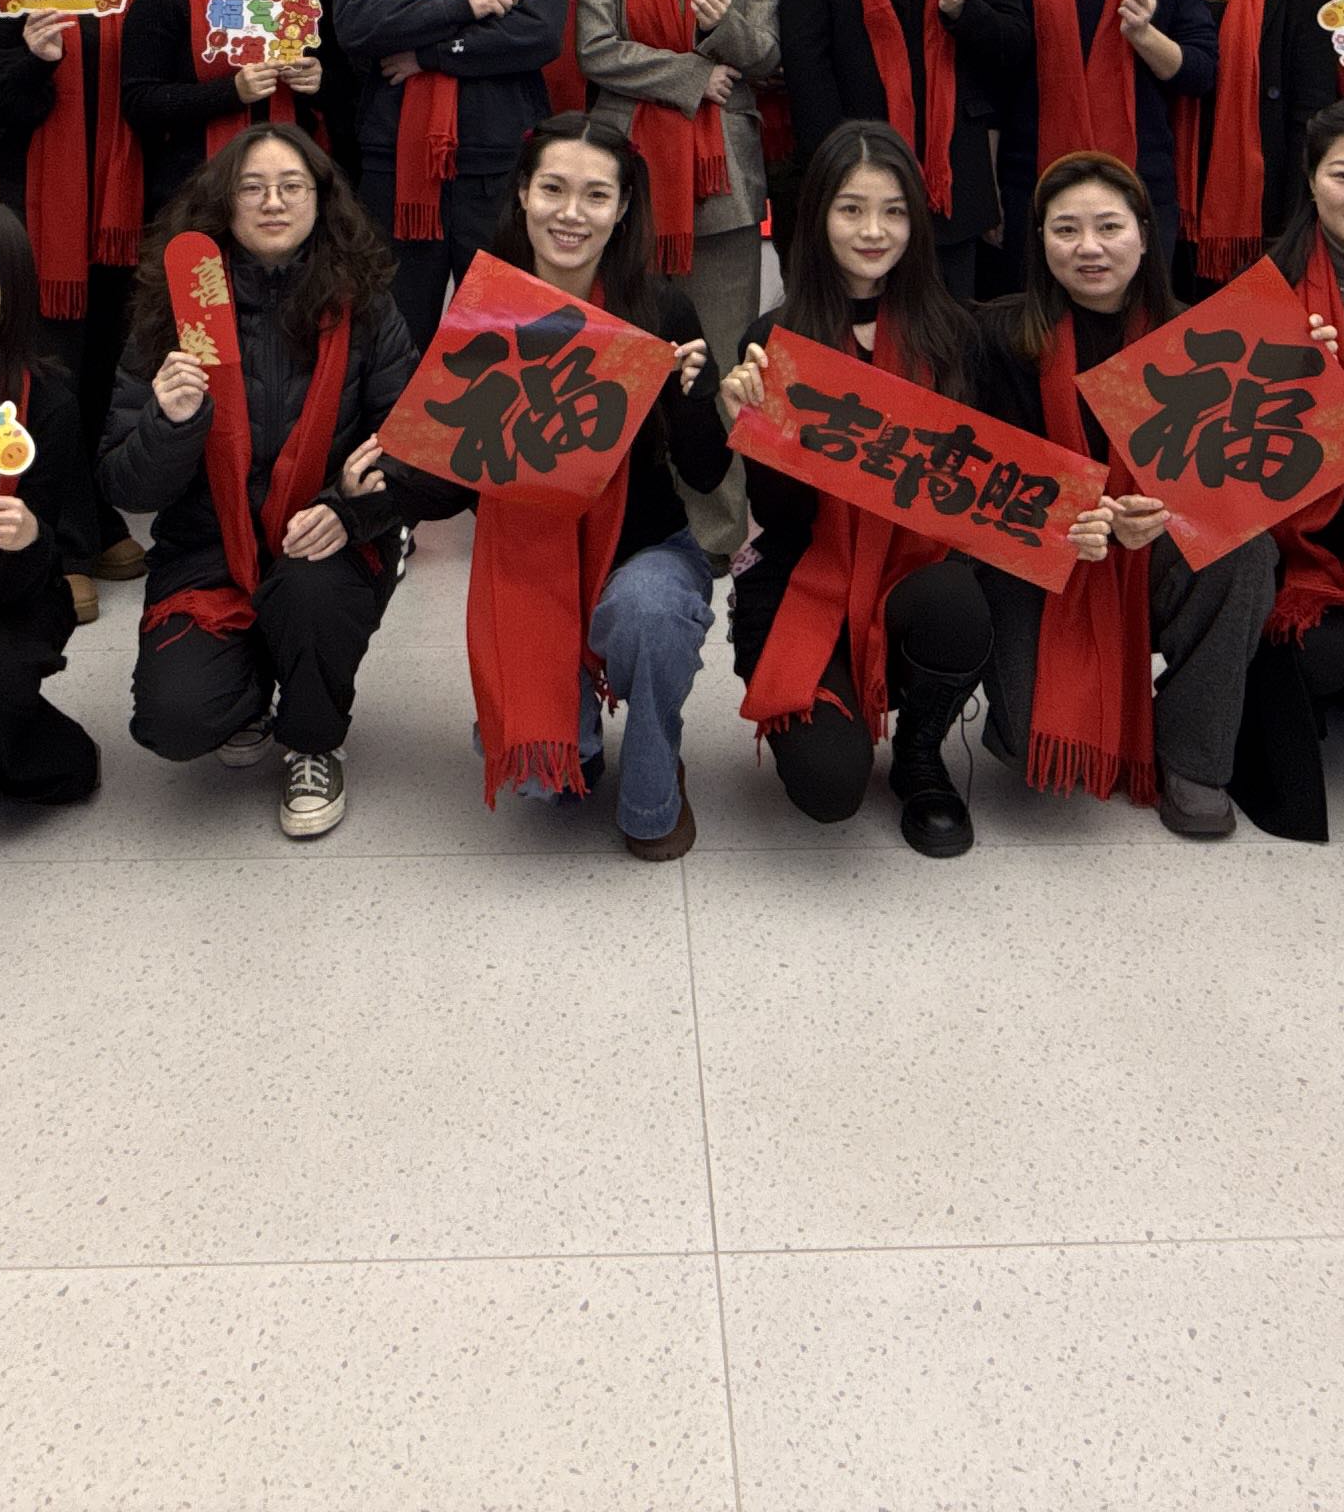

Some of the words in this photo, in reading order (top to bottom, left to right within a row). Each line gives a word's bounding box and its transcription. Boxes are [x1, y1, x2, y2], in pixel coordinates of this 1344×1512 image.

[424, 304, 627, 485] 福
[786, 383, 1060, 548] 吉星高照
[1128, 328, 1326, 502] 福
